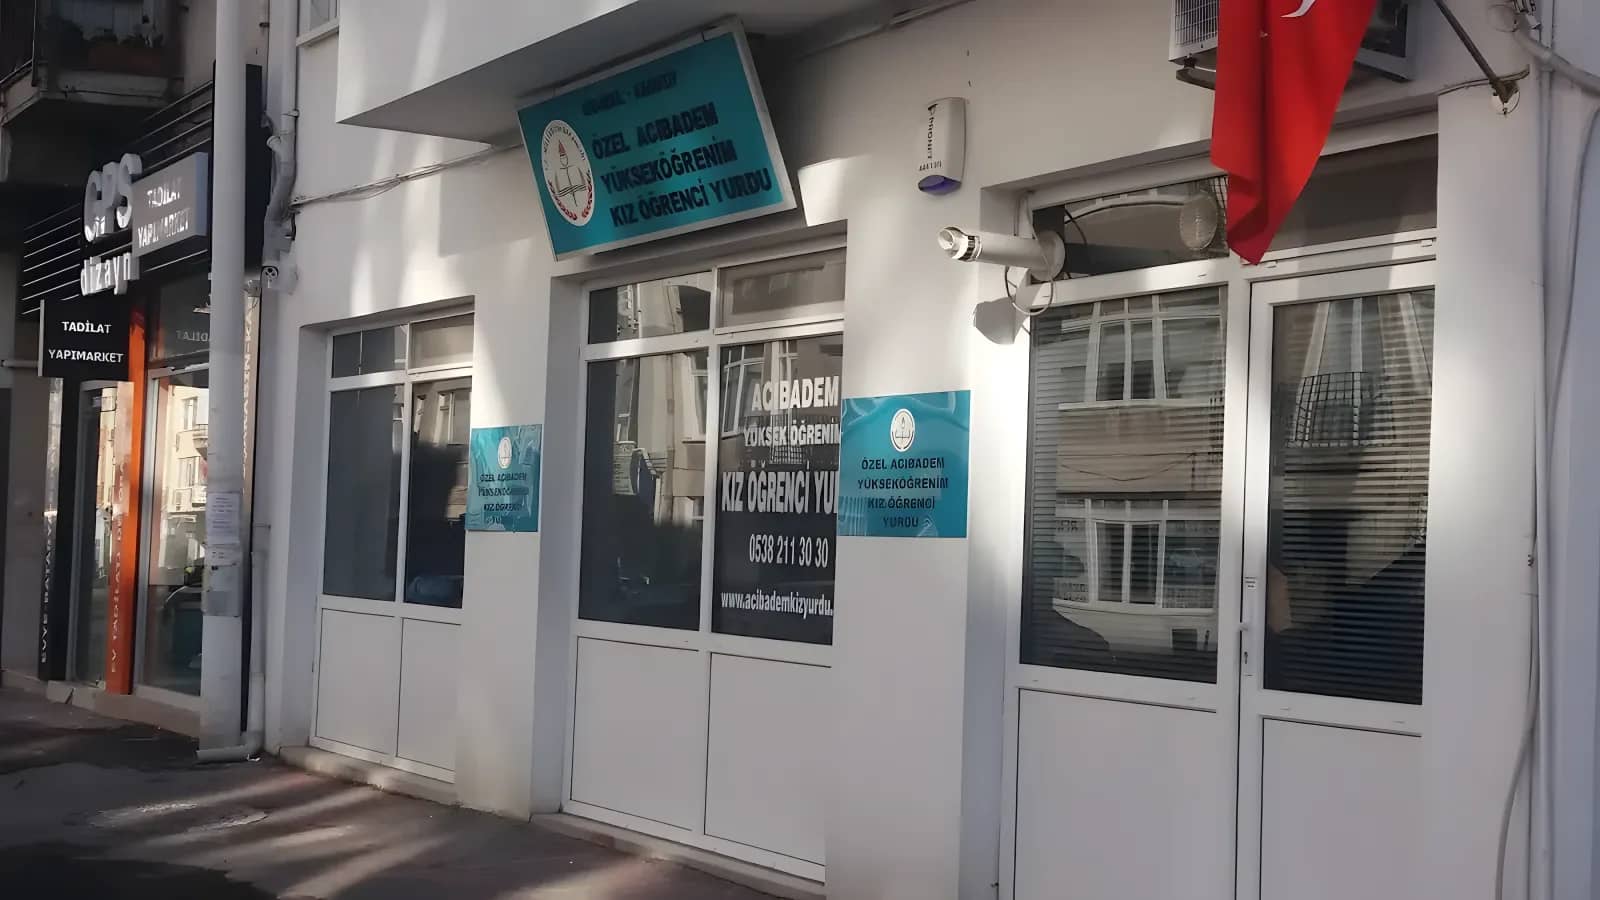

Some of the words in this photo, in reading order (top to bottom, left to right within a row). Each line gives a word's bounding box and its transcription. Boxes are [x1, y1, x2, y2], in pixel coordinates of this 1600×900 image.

[591, 130, 631, 160] ÖZEL
[636, 102, 719, 148] ACIBADEM
[600, 135, 738, 195] YÜKSEKÖĞRENİM
[609, 203, 639, 228] KIZ
[639, 179, 710, 221] ÖĞRENCİ
[711, 167, 773, 203] YURDU
[80, 252, 140, 296] dizayn
[61, 319, 112, 334] TADİLAT
[48, 348, 124, 363] YAPIMARKET
[751, 376, 840, 412] ACIBADEM
[743, 421, 788, 448] YÜKSEK
[861, 457, 887, 470] ÖZEL
[890, 457, 945, 470] ACIBADEM
[721, 471, 745, 512] KIZ
[747, 459, 811, 514] ÖĞRENCİ
[858, 475, 948, 489] YÜKSEKÖĞRENİM
[867, 496, 886, 509] KIZ
[887, 495, 935, 509] ÖĞRENCİ
[883, 516, 919, 528] YURDU
[749, 533, 774, 565] 0538
[776, 534, 796, 565] 211
[798, 535, 812, 568] 30
[814, 537, 829, 568] 30
